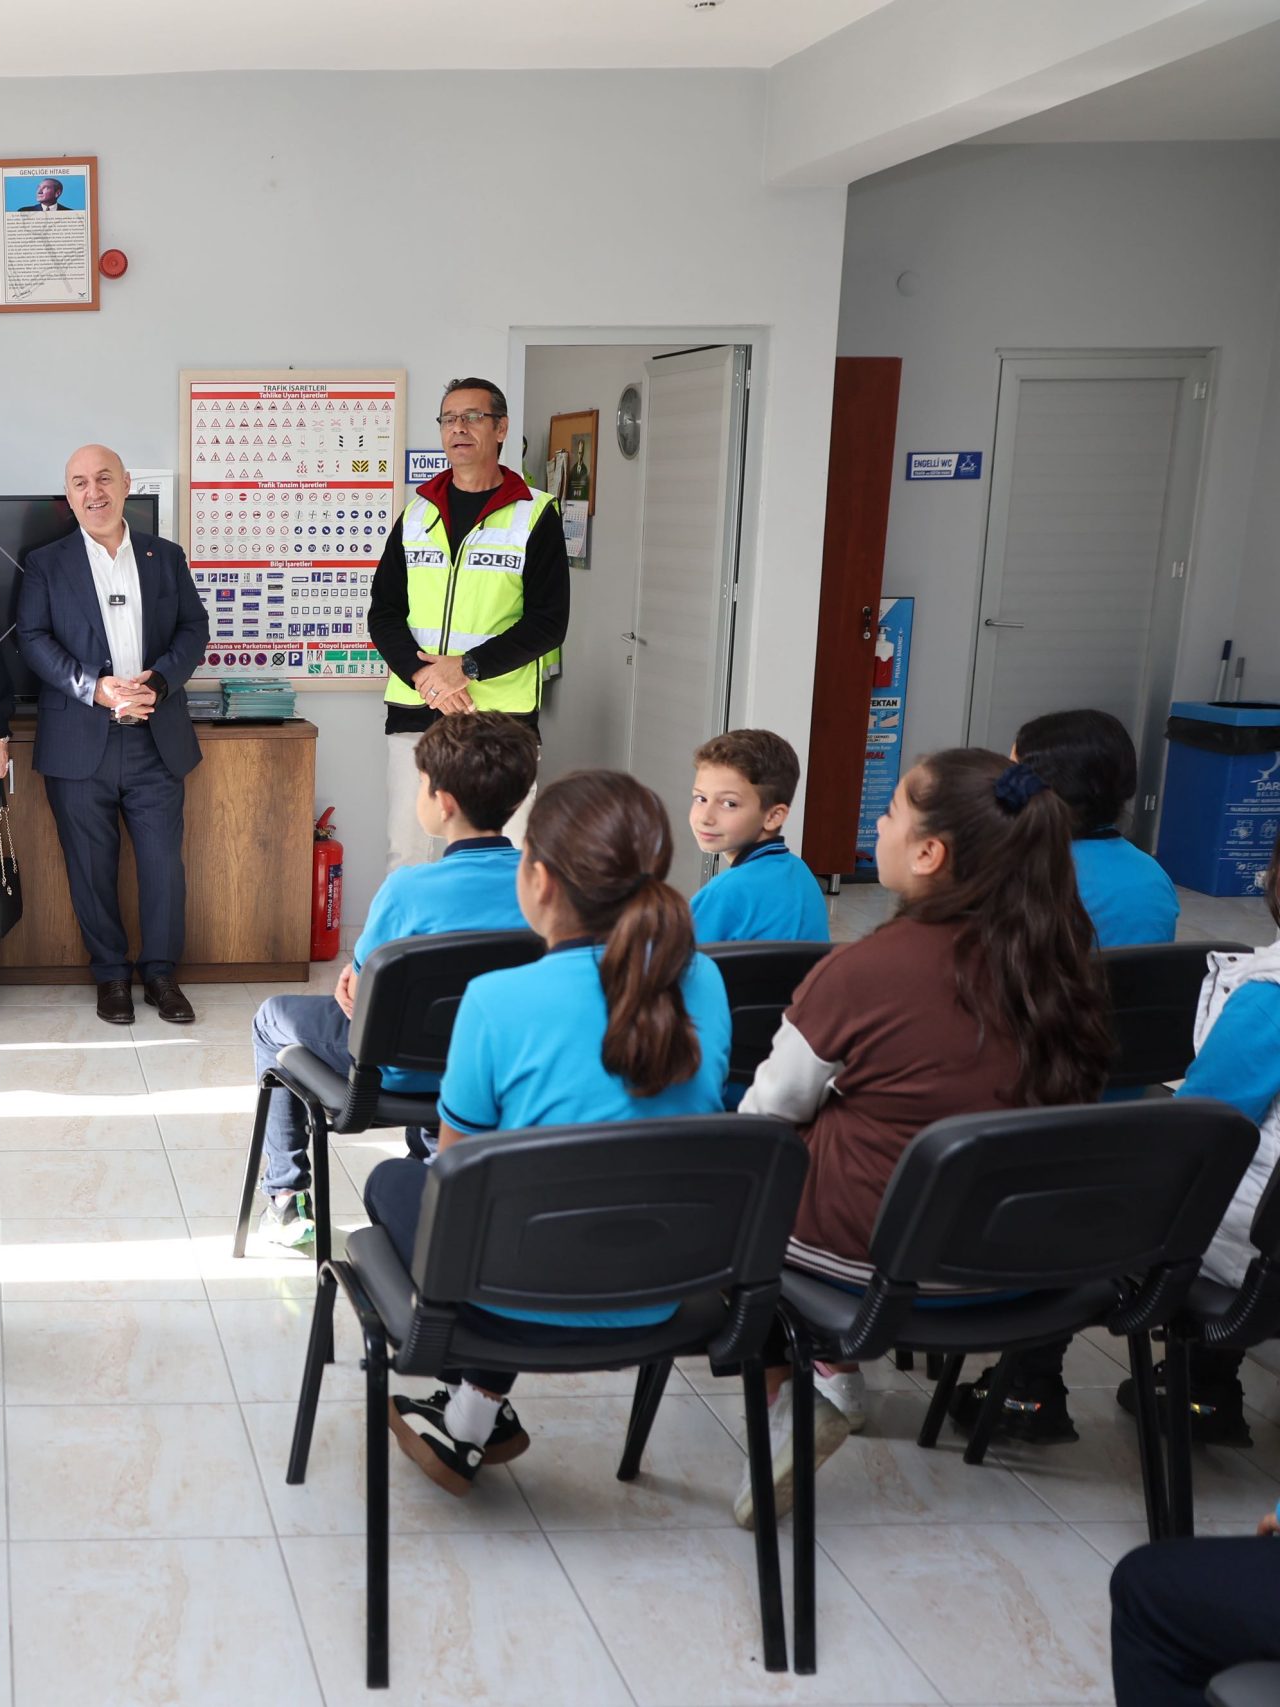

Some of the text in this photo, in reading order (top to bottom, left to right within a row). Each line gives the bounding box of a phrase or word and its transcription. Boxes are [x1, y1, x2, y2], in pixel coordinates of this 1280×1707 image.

[263, 384, 327, 392] TRAFİK İŞARETLERİ
[913, 457, 953, 468] ENGELLİ WC
[257, 481, 276, 489] Trafik
